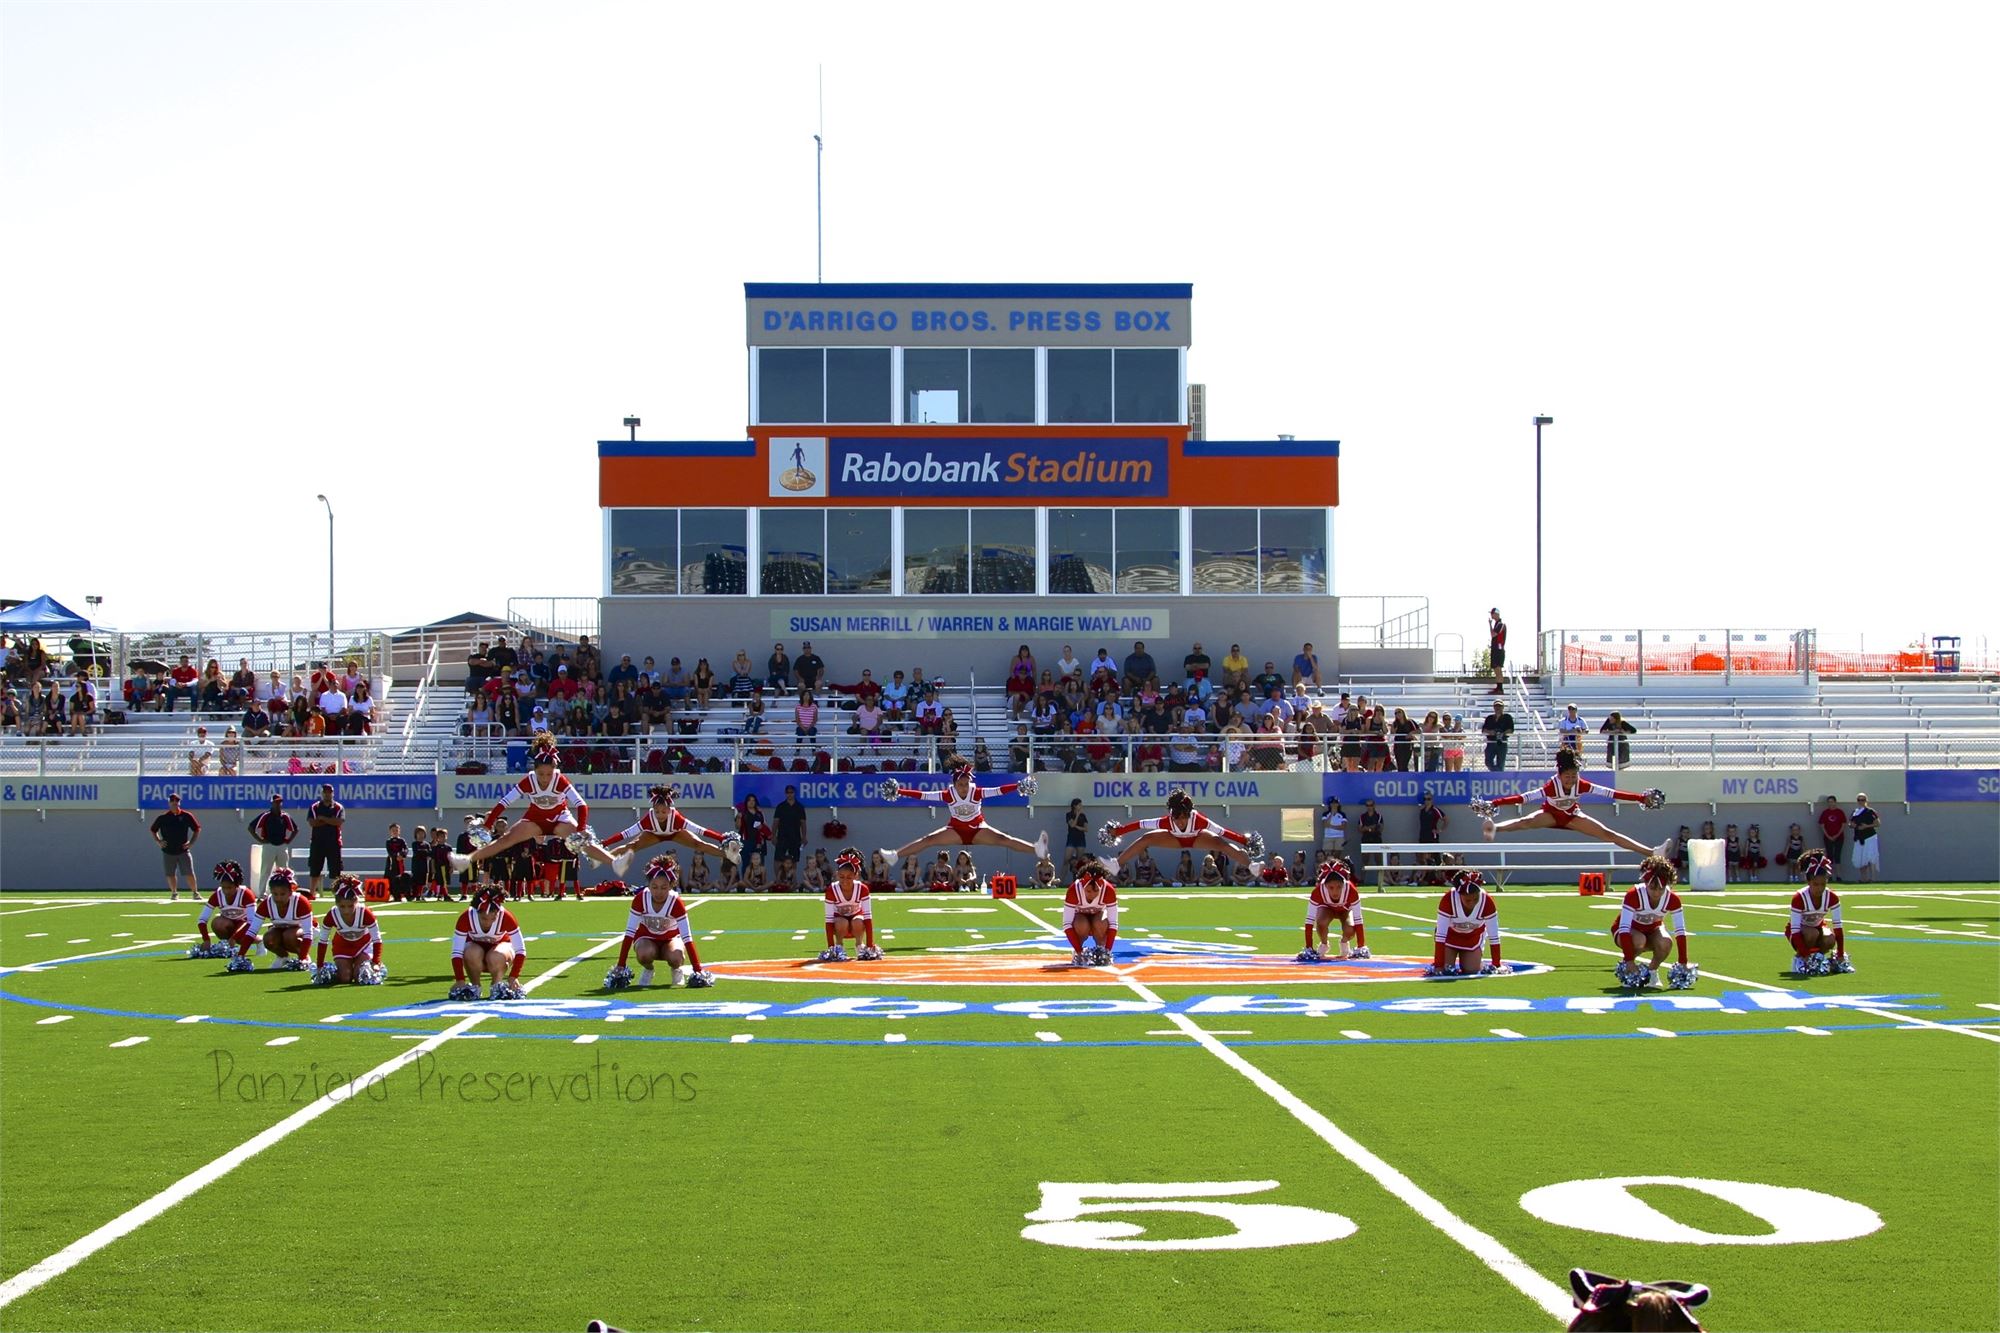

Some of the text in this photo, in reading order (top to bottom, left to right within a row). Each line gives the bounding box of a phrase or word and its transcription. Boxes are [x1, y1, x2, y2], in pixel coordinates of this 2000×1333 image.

[764, 310, 1171, 332] D'ARRIGO BROS. PRESS BOX
[841, 452, 1152, 483] Rabobank Stadium
[790, 616, 1153, 632] SUSAN MERRILL / WARREN & MARGIE WAYLAND
[3, 784, 98, 801] & GIANNINI
[142, 783, 432, 800] PACIFIC INTERNATIONA MARKETING
[800, 782, 840, 799] RICK
[844, 782, 857, 799] &
[1093, 781, 1133, 798] DICK
[1138, 781, 1150, 797] &
[1215, 781, 1259, 797] CAVA
[1374, 781, 1418, 797] GOLD
[1424, 780, 1466, 796] STAR
[1472, 780, 1521, 796] BUICK
[1722, 778, 1798, 795] MY CARS
[366, 881, 385, 898] 40
[996, 878, 1014, 896] 50
[1584, 876, 1602, 893] 40
